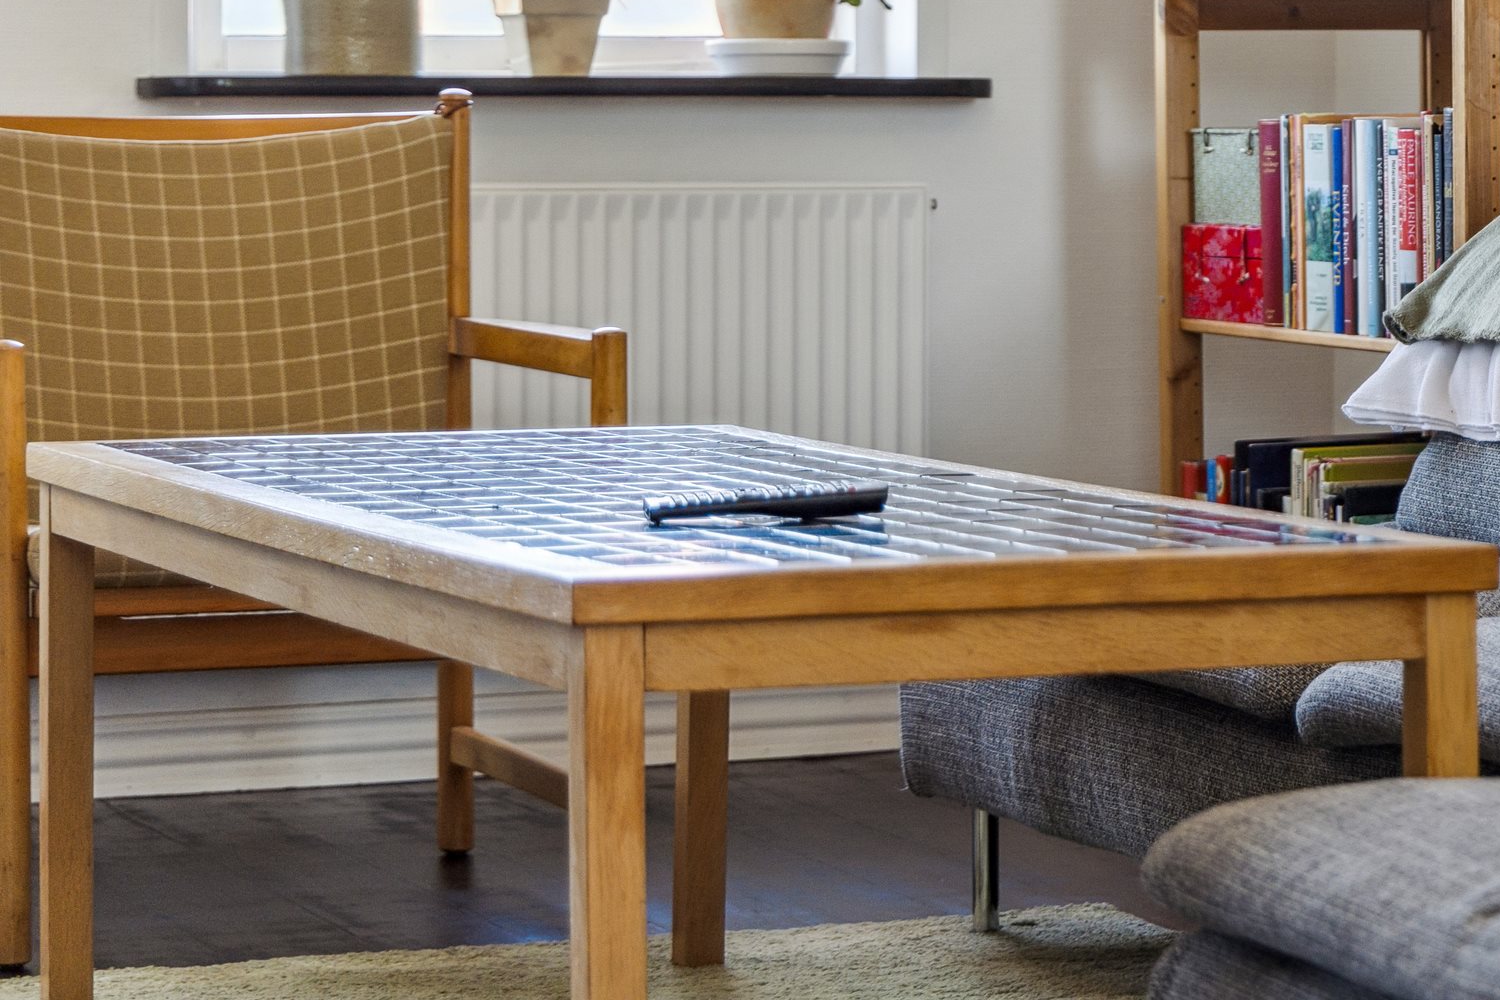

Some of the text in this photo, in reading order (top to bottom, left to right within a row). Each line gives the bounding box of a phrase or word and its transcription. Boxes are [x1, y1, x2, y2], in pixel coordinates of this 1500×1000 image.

[1331, 190, 1341, 286] EVENTYR
[1407, 139, 1416, 246] PALLE LAURING
